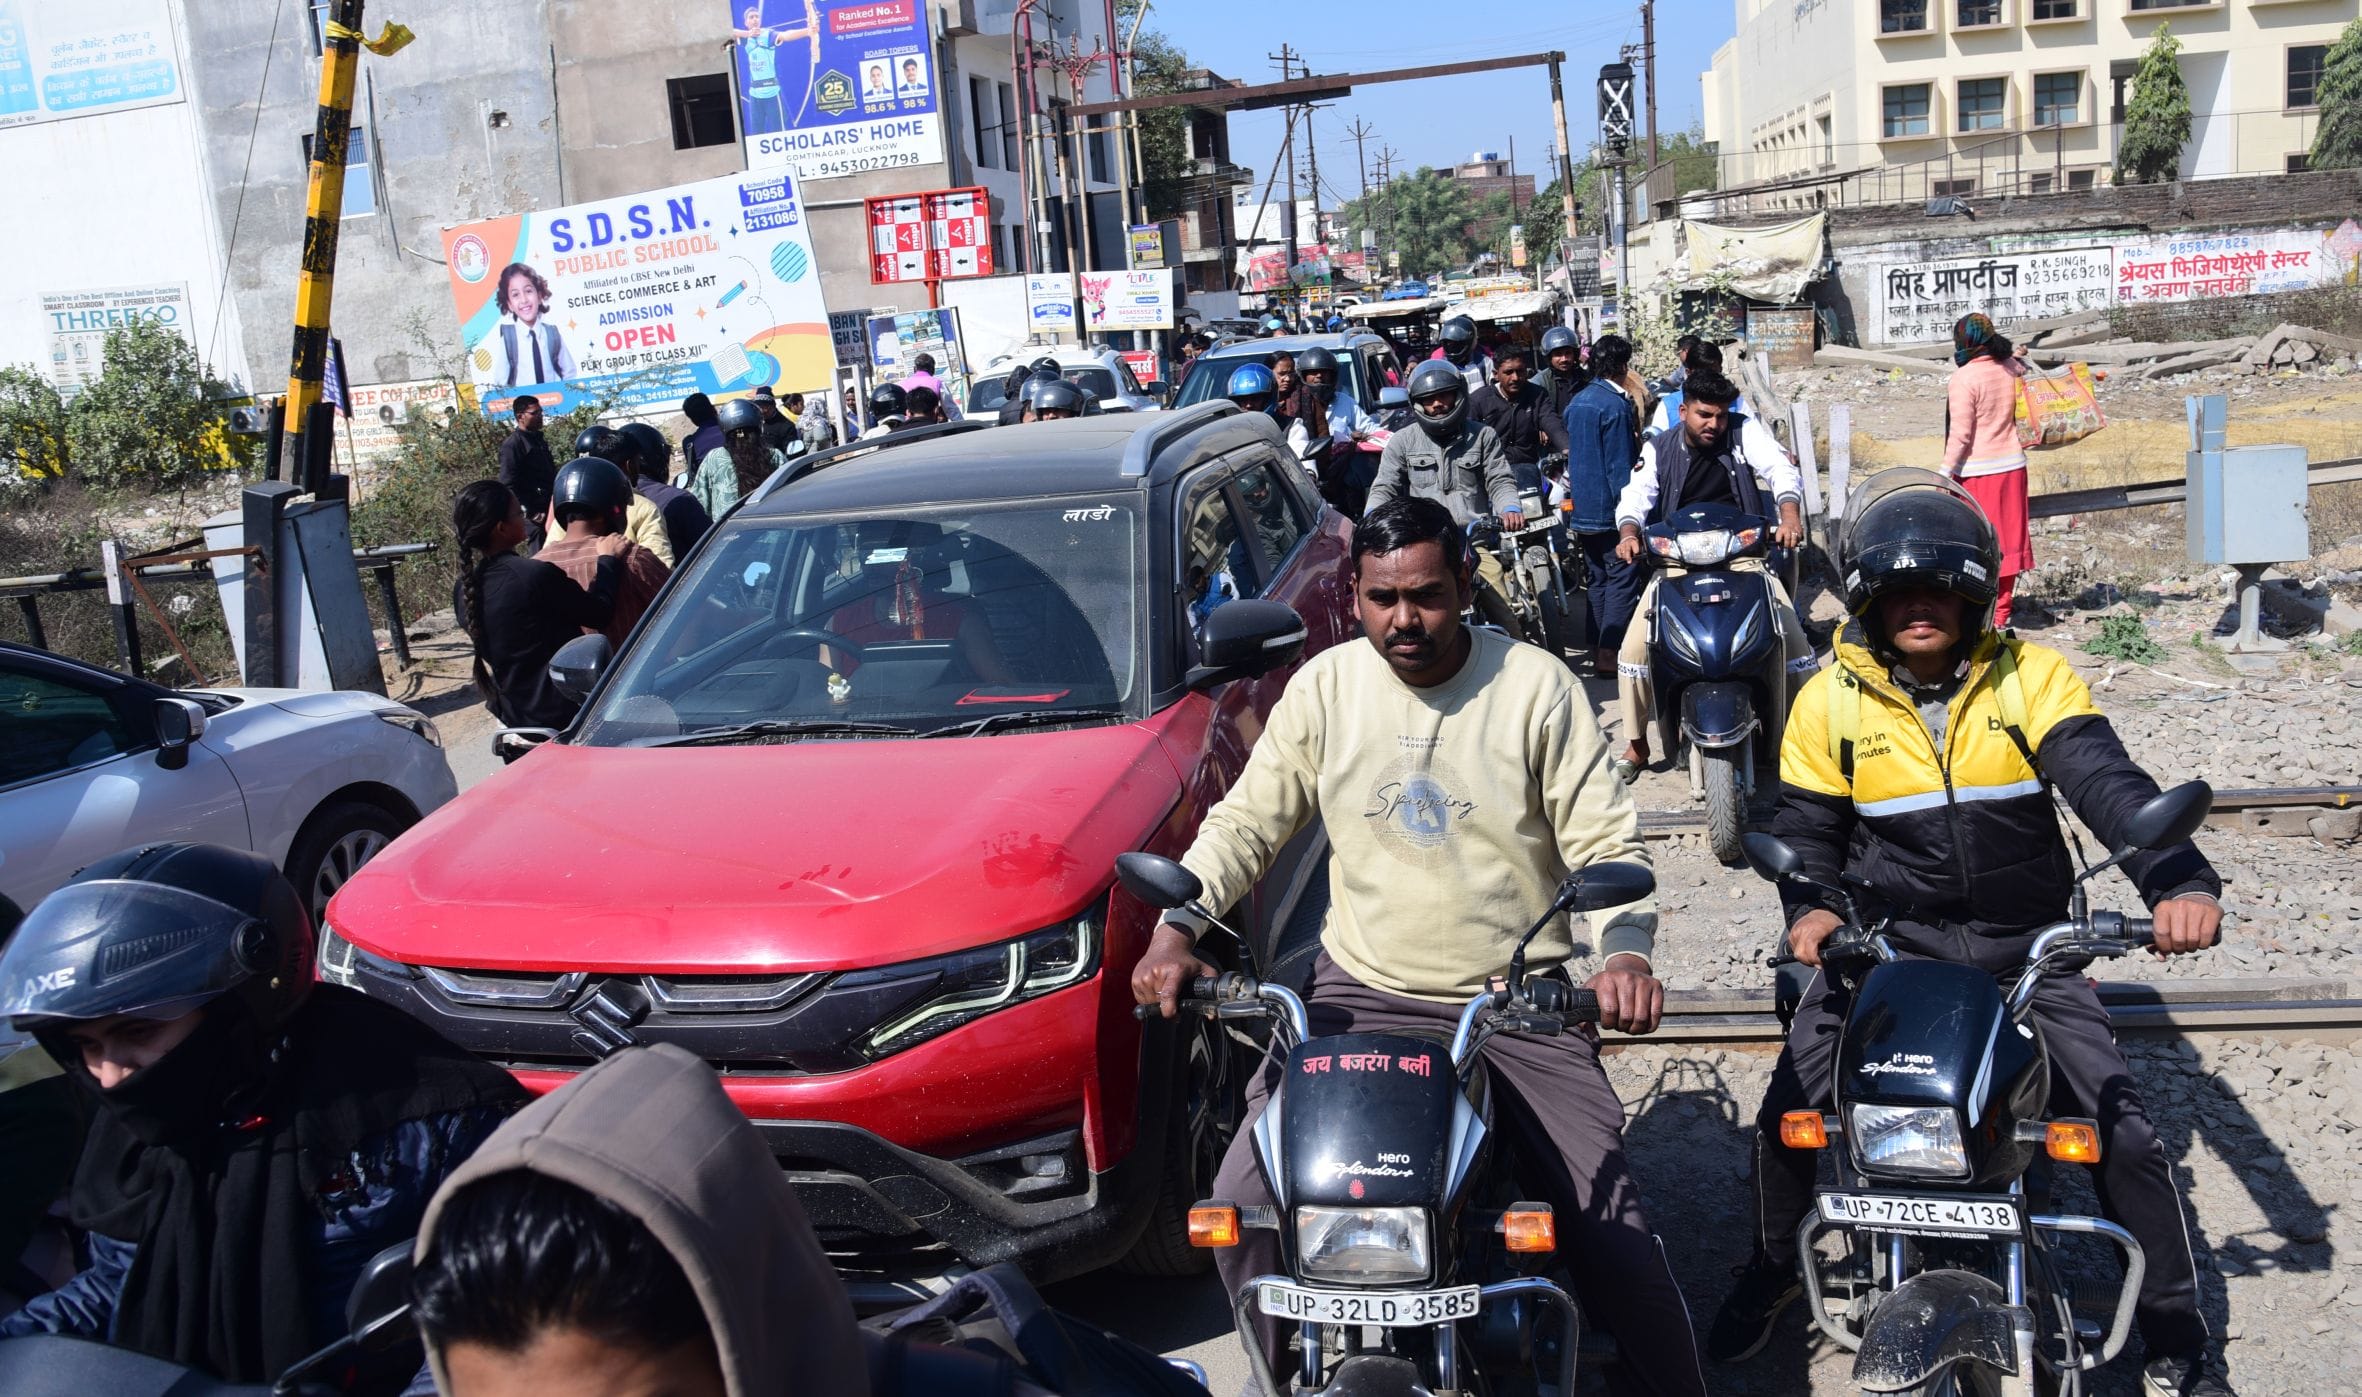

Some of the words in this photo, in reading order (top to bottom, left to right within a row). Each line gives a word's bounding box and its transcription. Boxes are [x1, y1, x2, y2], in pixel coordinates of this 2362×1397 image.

[838, 8, 874, 22] Ranked
[876, 6, 894, 17] No.
[895, 4, 902, 14] 1
[836, 23, 846, 31] for
[846, 19, 877, 30] Academic
[877, 15, 910, 26] Excellence
[845, 31, 864, 40] School
[864, 28, 893, 38] Excellence
[893, 25, 914, 35] Awards
[864, 48, 888, 59] BOARD
[889, 44, 919, 55] TOPPERS
[824, 81, 845, 96] 25
[864, 103, 885, 114] 98.6
[887, 102, 896, 111] %
[903, 99, 916, 110] 98
[917, 98, 927, 108] %
[759, 128, 864, 155] SCHOLARS'
[870, 120, 925, 141] HOME
[786, 149, 850, 162] GOMTINAGAR,
[851, 142, 899, 154] LUCKNOW
[819, 152, 920, 176] 9453022798
[745, 179, 766, 190] School
[767, 177, 784, 187] Code
[746, 185, 786, 204] 70958
[747, 204, 778, 216] Affiliation
[779, 203, 791, 212] No.
[548, 195, 712, 253] S.D.S.N.
[744, 210, 798, 231] 2131086
[553, 248, 628, 277] PUBLIC
[633, 233, 721, 264] SCHOOL
[2054, 255, 2087, 268] SINGH
[2024, 263, 2111, 285] 9235669218
[2119, 260, 2167, 283] श्रेयस
[2271, 250, 2312, 269] सेन्टर
[583, 273, 619, 291] Affiliated
[620, 272, 629, 284] to
[630, 269, 652, 284] CBSE
[653, 266, 673, 280] New
[673, 262, 696, 277] Delhi
[1887, 268, 1932, 301] सिंह
[1932, 260, 2019, 295] प्रापर्टीज
[91, 292, 104, 300] Best
[136, 290, 154, 298] Online
[155, 287, 181, 297] Coaching
[567, 290, 616, 310] SCIENCE,
[618, 281, 681, 301] COMMERCE
[683, 280, 692, 292] &
[695, 274, 718, 289] ART
[2118, 285, 2137, 300] डा.
[2142, 282, 2191, 298] श्रवण
[43, 302, 65, 311] SMART
[67, 301, 105, 310] CLASSROOM
[113, 299, 120, 307] BY
[121, 297, 155, 307] EXPERIENCED
[156, 294, 181, 304] TEACHERS
[599, 302, 674, 326] ADMISSION
[604, 322, 676, 352] OPEN
[580, 360, 604, 372] PLAY
[606, 353, 638, 368] GROUP
[639, 351, 654, 363] TO
[655, 346, 687, 361] CLASS
[1062, 504, 1117, 523] लाडो
[1694, 577, 1726, 587] HONDA
[1874, 731, 1887, 742] in
[1302, 1055, 1331, 1075] जय
[1339, 1050, 1391, 1072] बजरंग
[1398, 1055, 1431, 1077] बली
[1904, 1053, 1934, 1064] Hero
[1377, 1152, 1411, 1164] Hero
[1845, 1199, 1872, 1219] UP
[1882, 1200, 1941, 1223] 72CE
[1953, 1203, 2011, 1227] 4138
[1288, 1294, 1316, 1317] UP
[1330, 1299, 1398, 1323] 32LD
[1412, 1292, 1476, 1322] 3585
